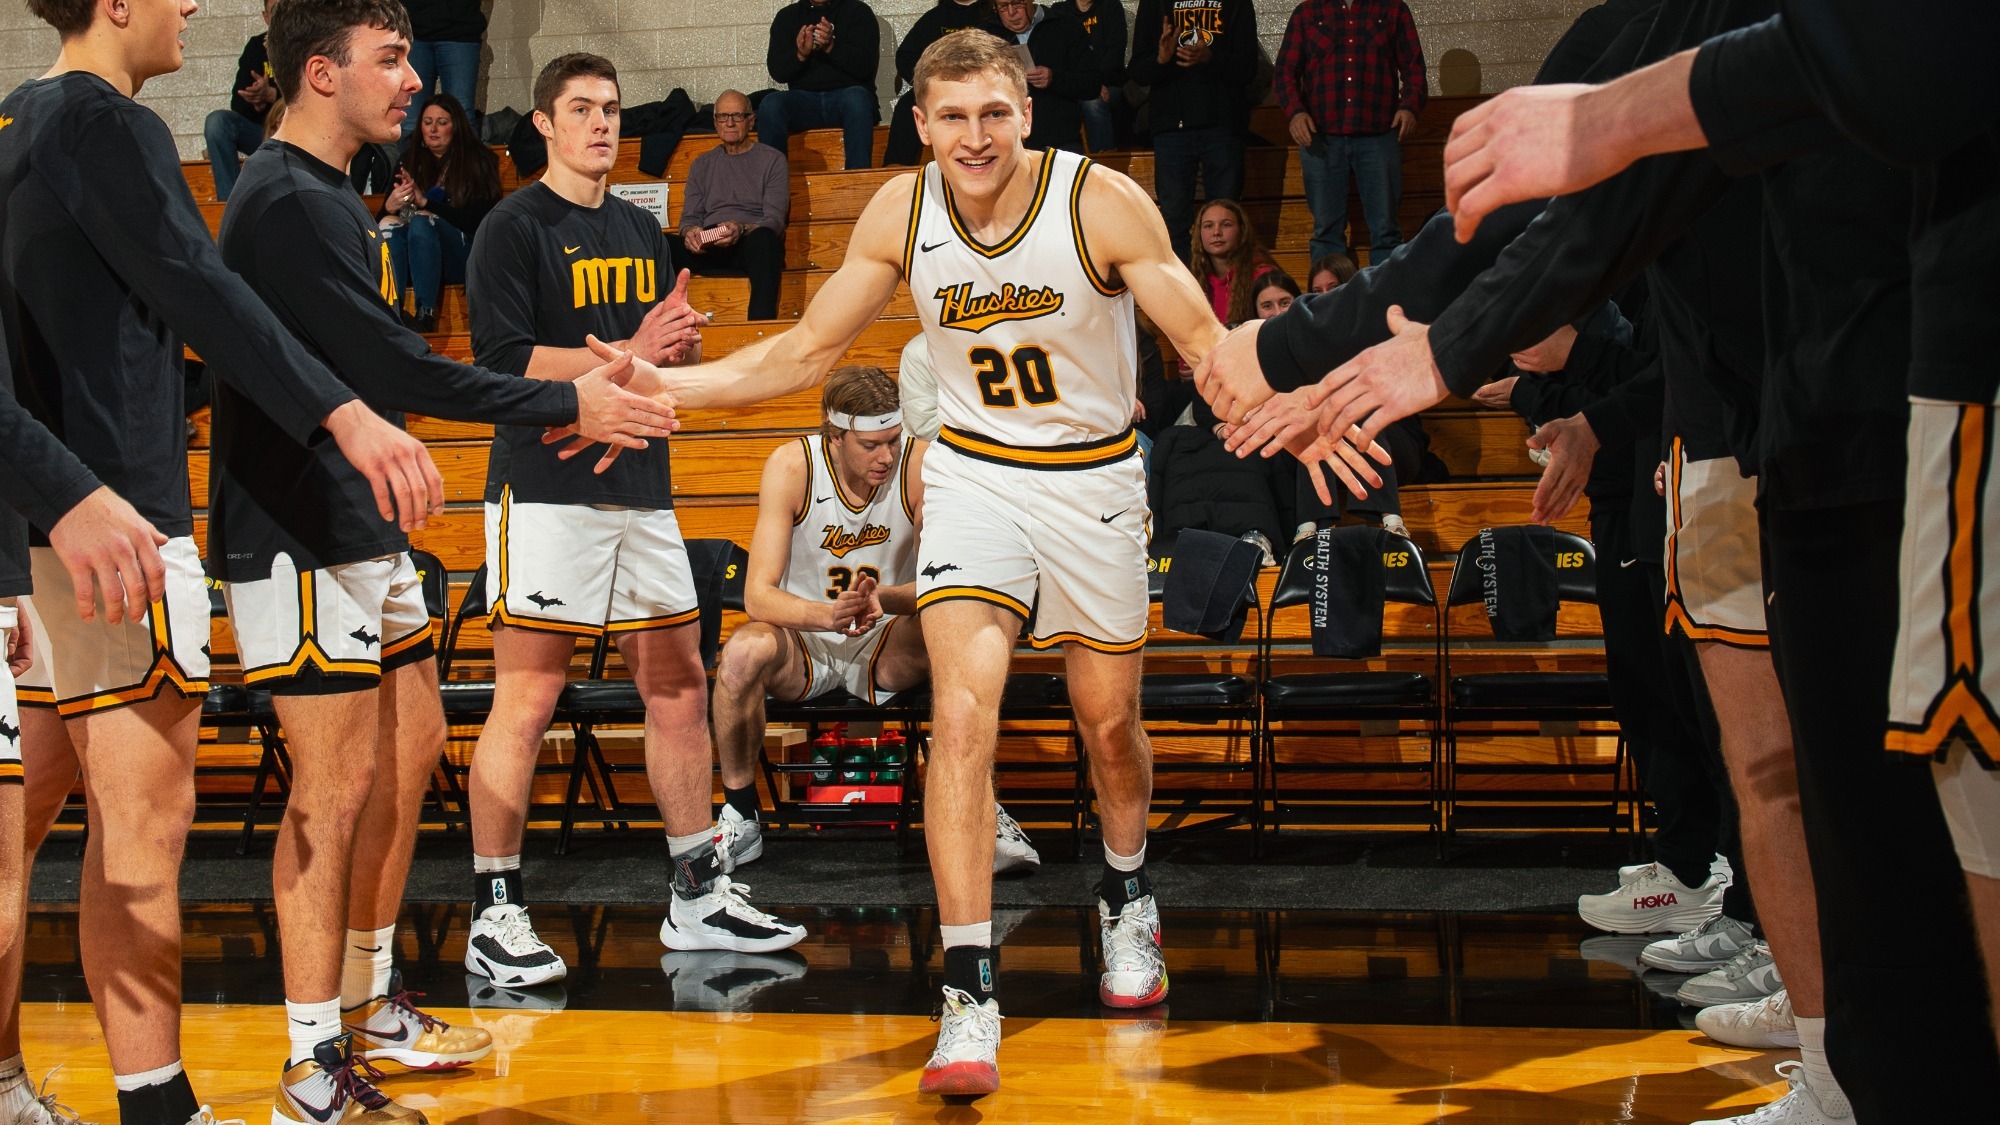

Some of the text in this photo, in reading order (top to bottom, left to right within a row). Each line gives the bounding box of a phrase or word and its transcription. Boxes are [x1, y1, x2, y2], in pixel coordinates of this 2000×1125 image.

[572, 257, 656, 309] MTU
[933, 281, 1064, 328] Huskies
[967, 344, 1061, 408] 20
[1314, 528, 1332, 628] HEALTH SYSTEM
[1483, 562, 1498, 617] SYSTEM
[1633, 892, 1678, 910] HOKA
